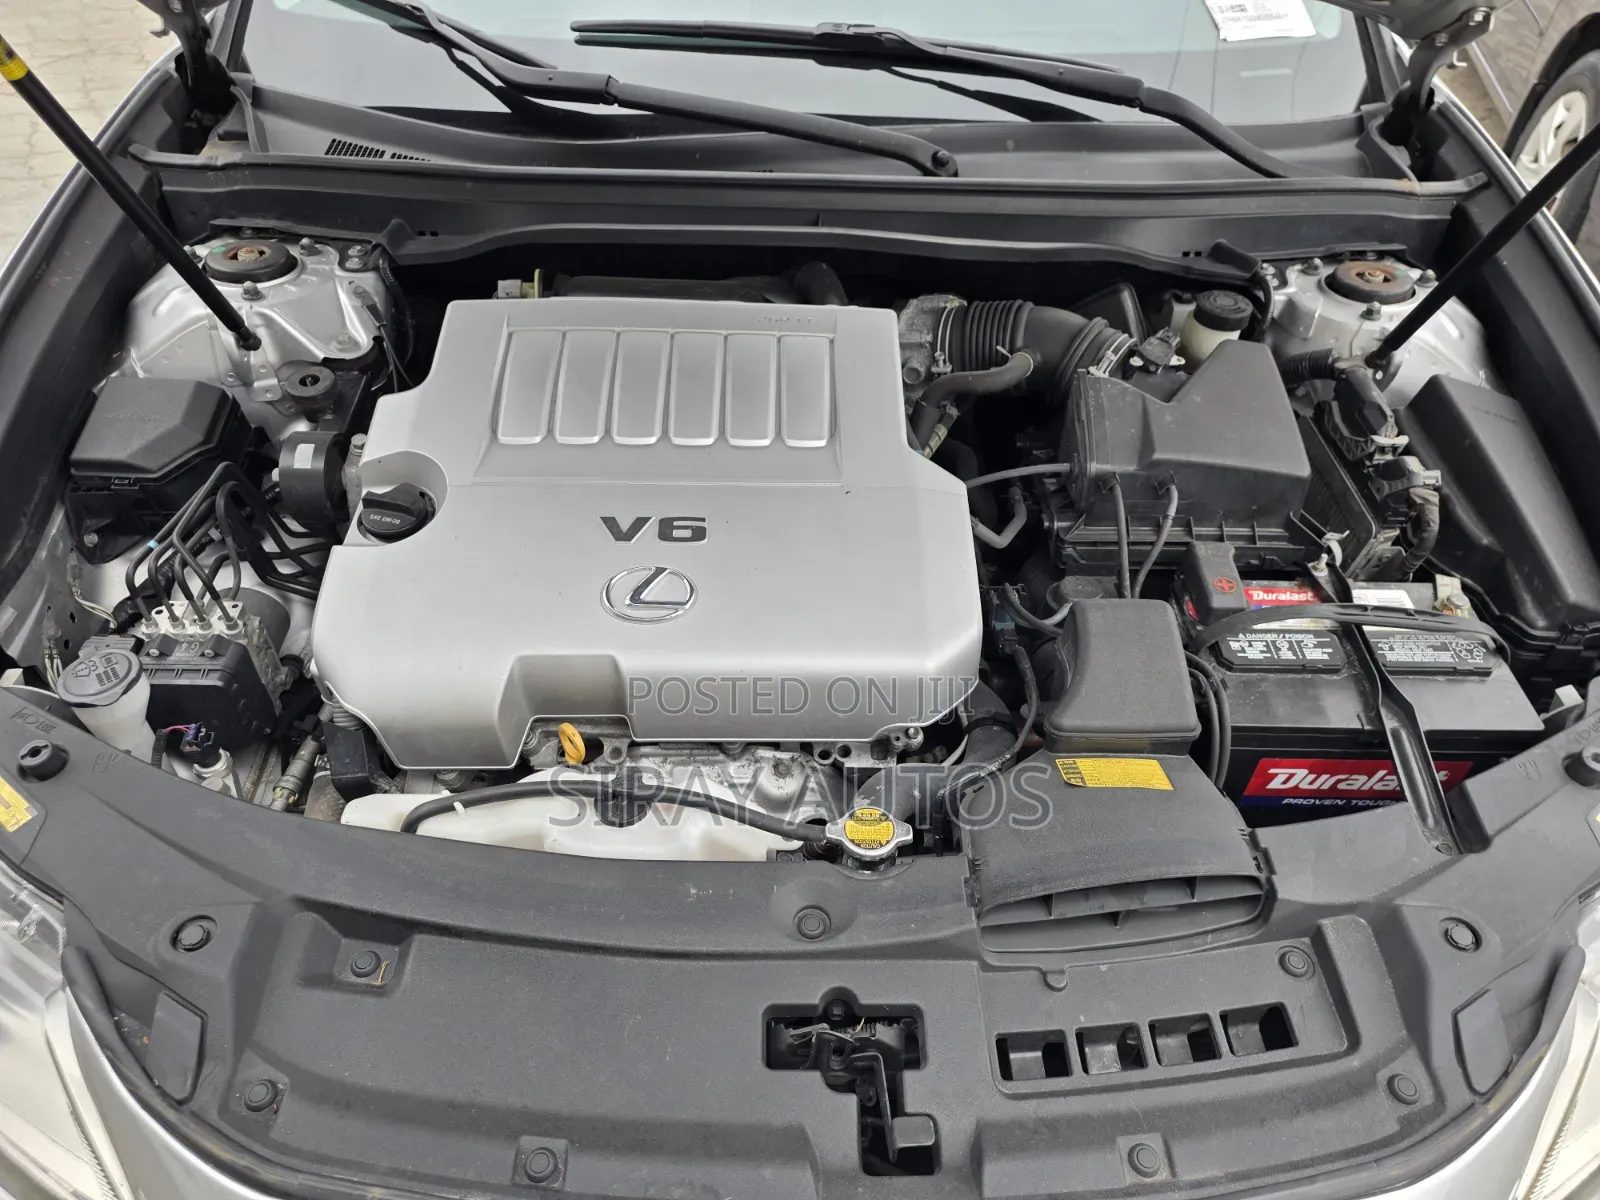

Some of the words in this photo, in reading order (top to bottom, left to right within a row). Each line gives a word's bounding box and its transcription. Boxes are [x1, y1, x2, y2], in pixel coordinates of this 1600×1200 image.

[597, 516, 708, 545] V6
[1248, 590, 1315, 601] Duralast
[1266, 768, 1450, 791] Durala
[1281, 798, 1347, 806] PROVEN
